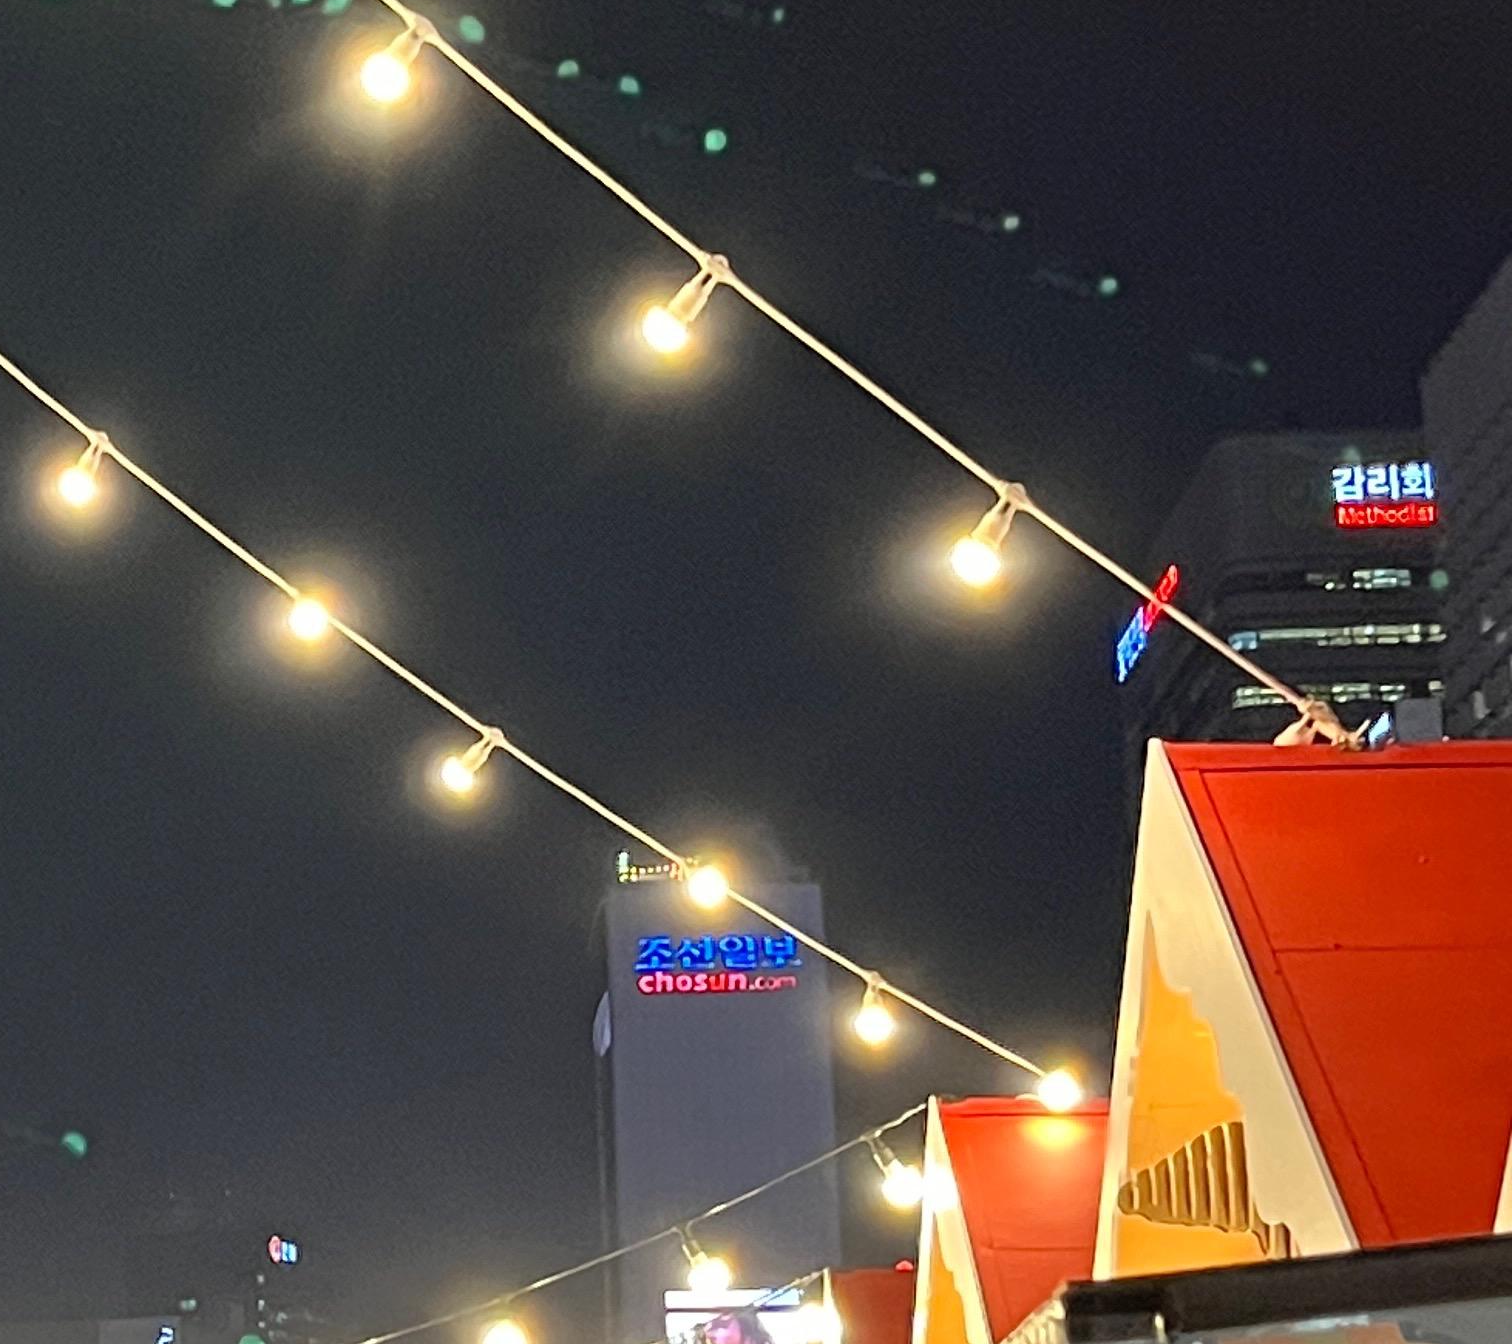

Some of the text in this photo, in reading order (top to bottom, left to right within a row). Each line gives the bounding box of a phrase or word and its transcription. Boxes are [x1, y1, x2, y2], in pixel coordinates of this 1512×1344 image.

[1331, 462, 1435, 502] 감리회
[634, 935, 803, 971] 조선일보
[638, 970, 797, 993] chosun.com
